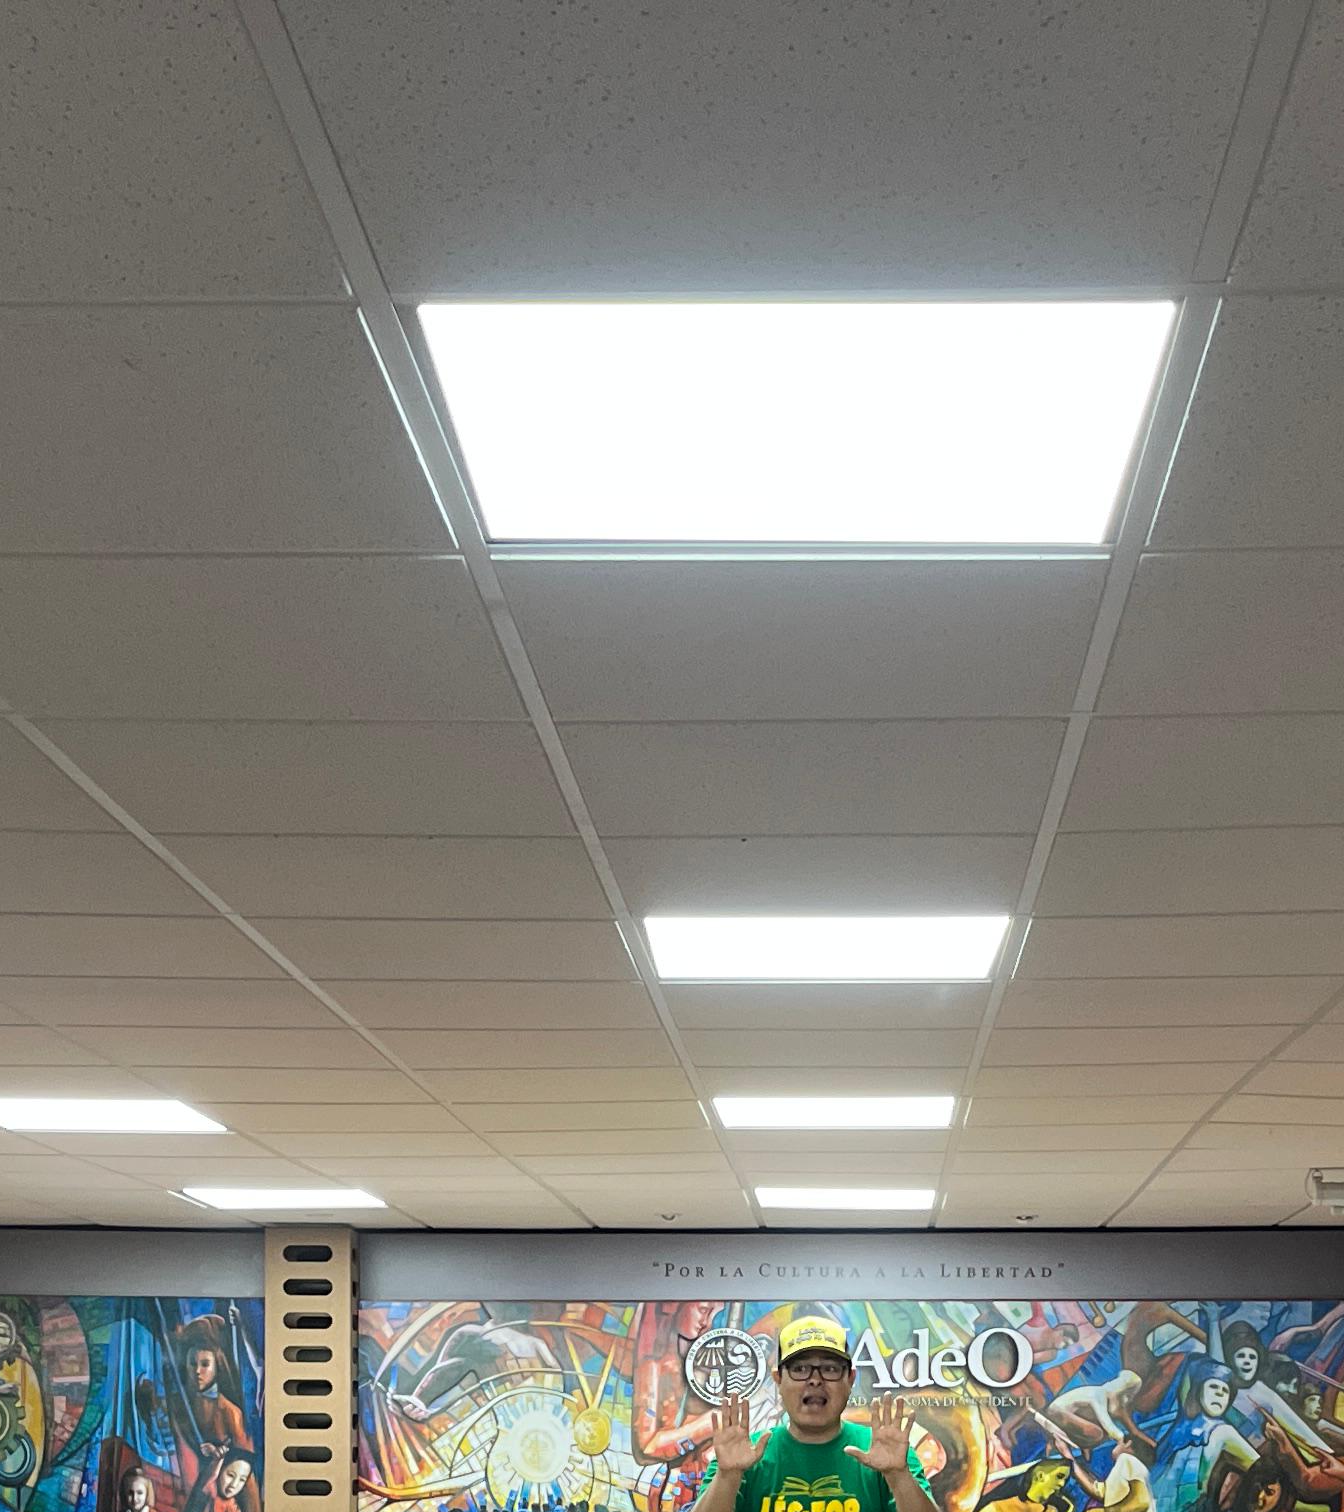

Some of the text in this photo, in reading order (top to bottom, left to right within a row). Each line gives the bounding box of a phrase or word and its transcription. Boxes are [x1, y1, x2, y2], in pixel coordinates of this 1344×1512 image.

[719, 1266, 744, 1278] LA
[759, 1263, 861, 1278] CULTURA
[875, 1267, 886, 1278] A
[901, 1267, 926, 1278] LA
[845, 1327, 1033, 1388] AdeO
